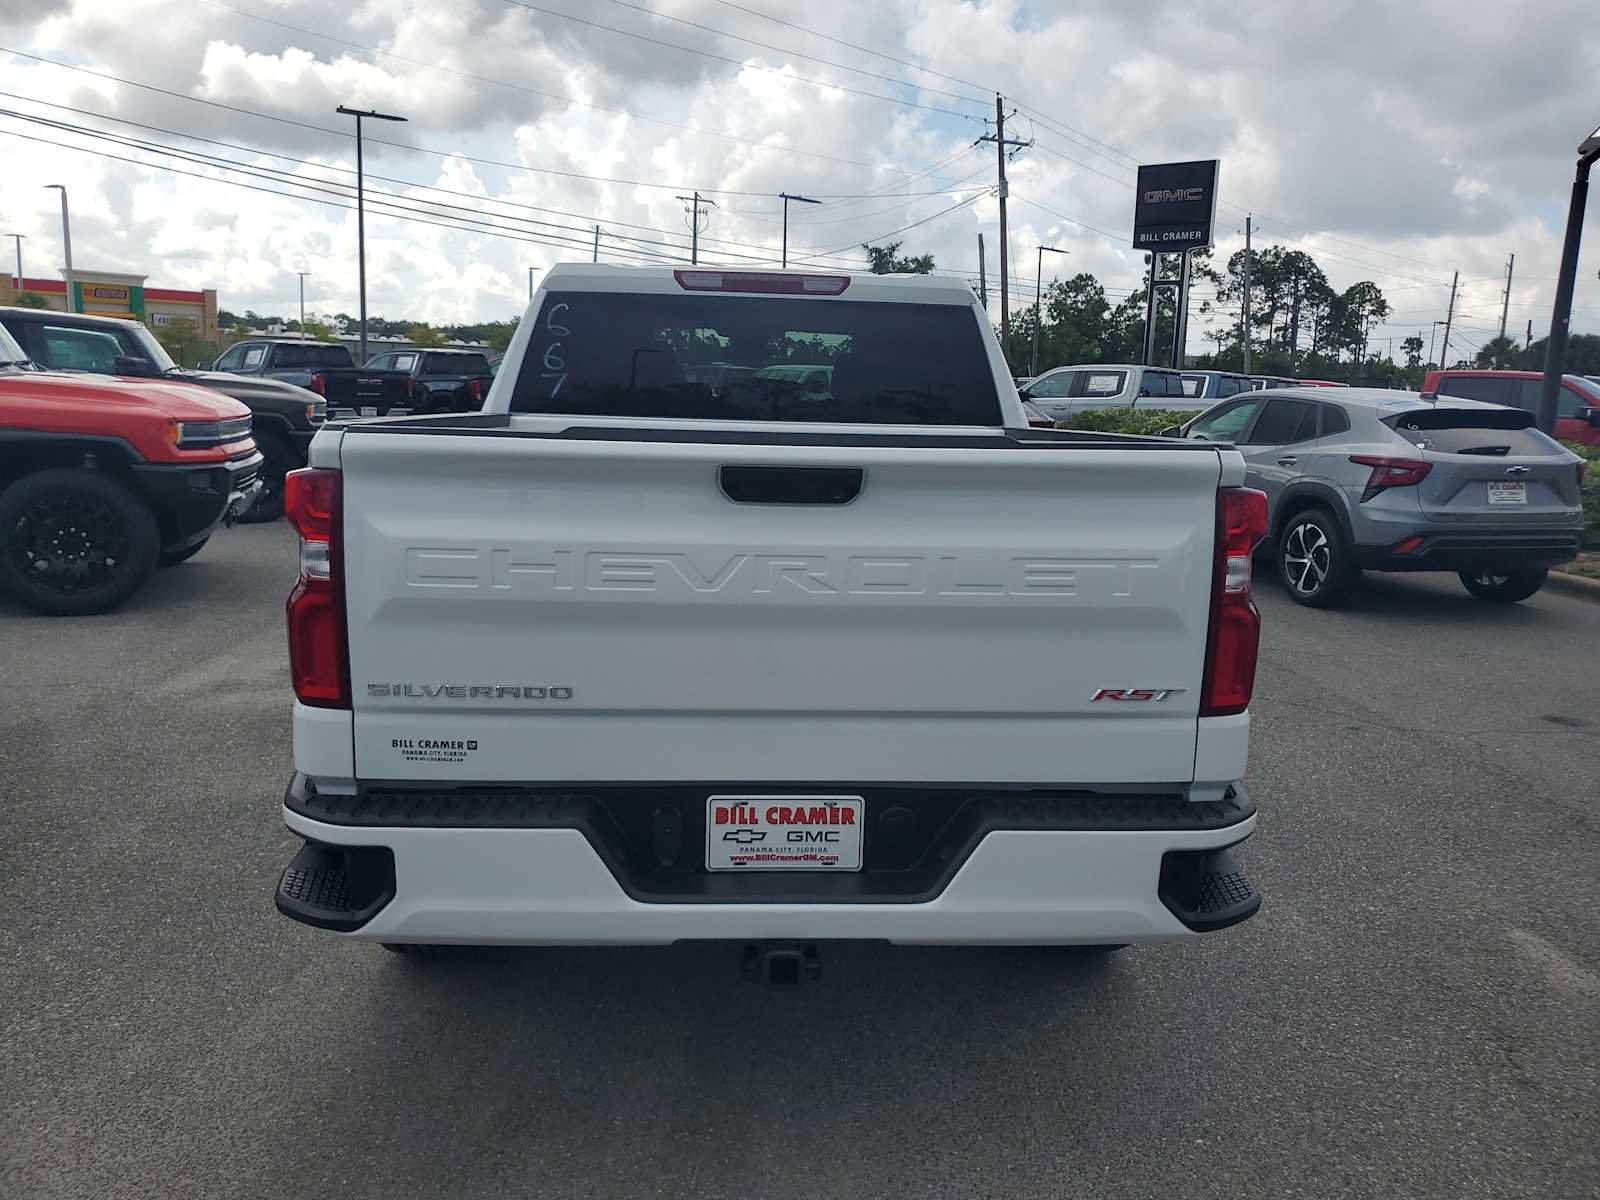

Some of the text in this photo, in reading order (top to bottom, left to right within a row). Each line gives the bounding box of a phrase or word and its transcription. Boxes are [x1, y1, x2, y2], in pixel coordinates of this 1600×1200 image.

[1143, 188, 1203, 204] GMC
[1140, 231, 1202, 242] BILL CRAMER
[405, 547, 1159, 597] CHEVROLET
[367, 683, 573, 699] SILVERADO
[1090, 688, 1187, 702] RST
[392, 739, 414, 748] BILL
[418, 740, 464, 750] CRAMER
[715, 806, 855, 825] BILL CRAMER
[787, 831, 840, 842] GMC
